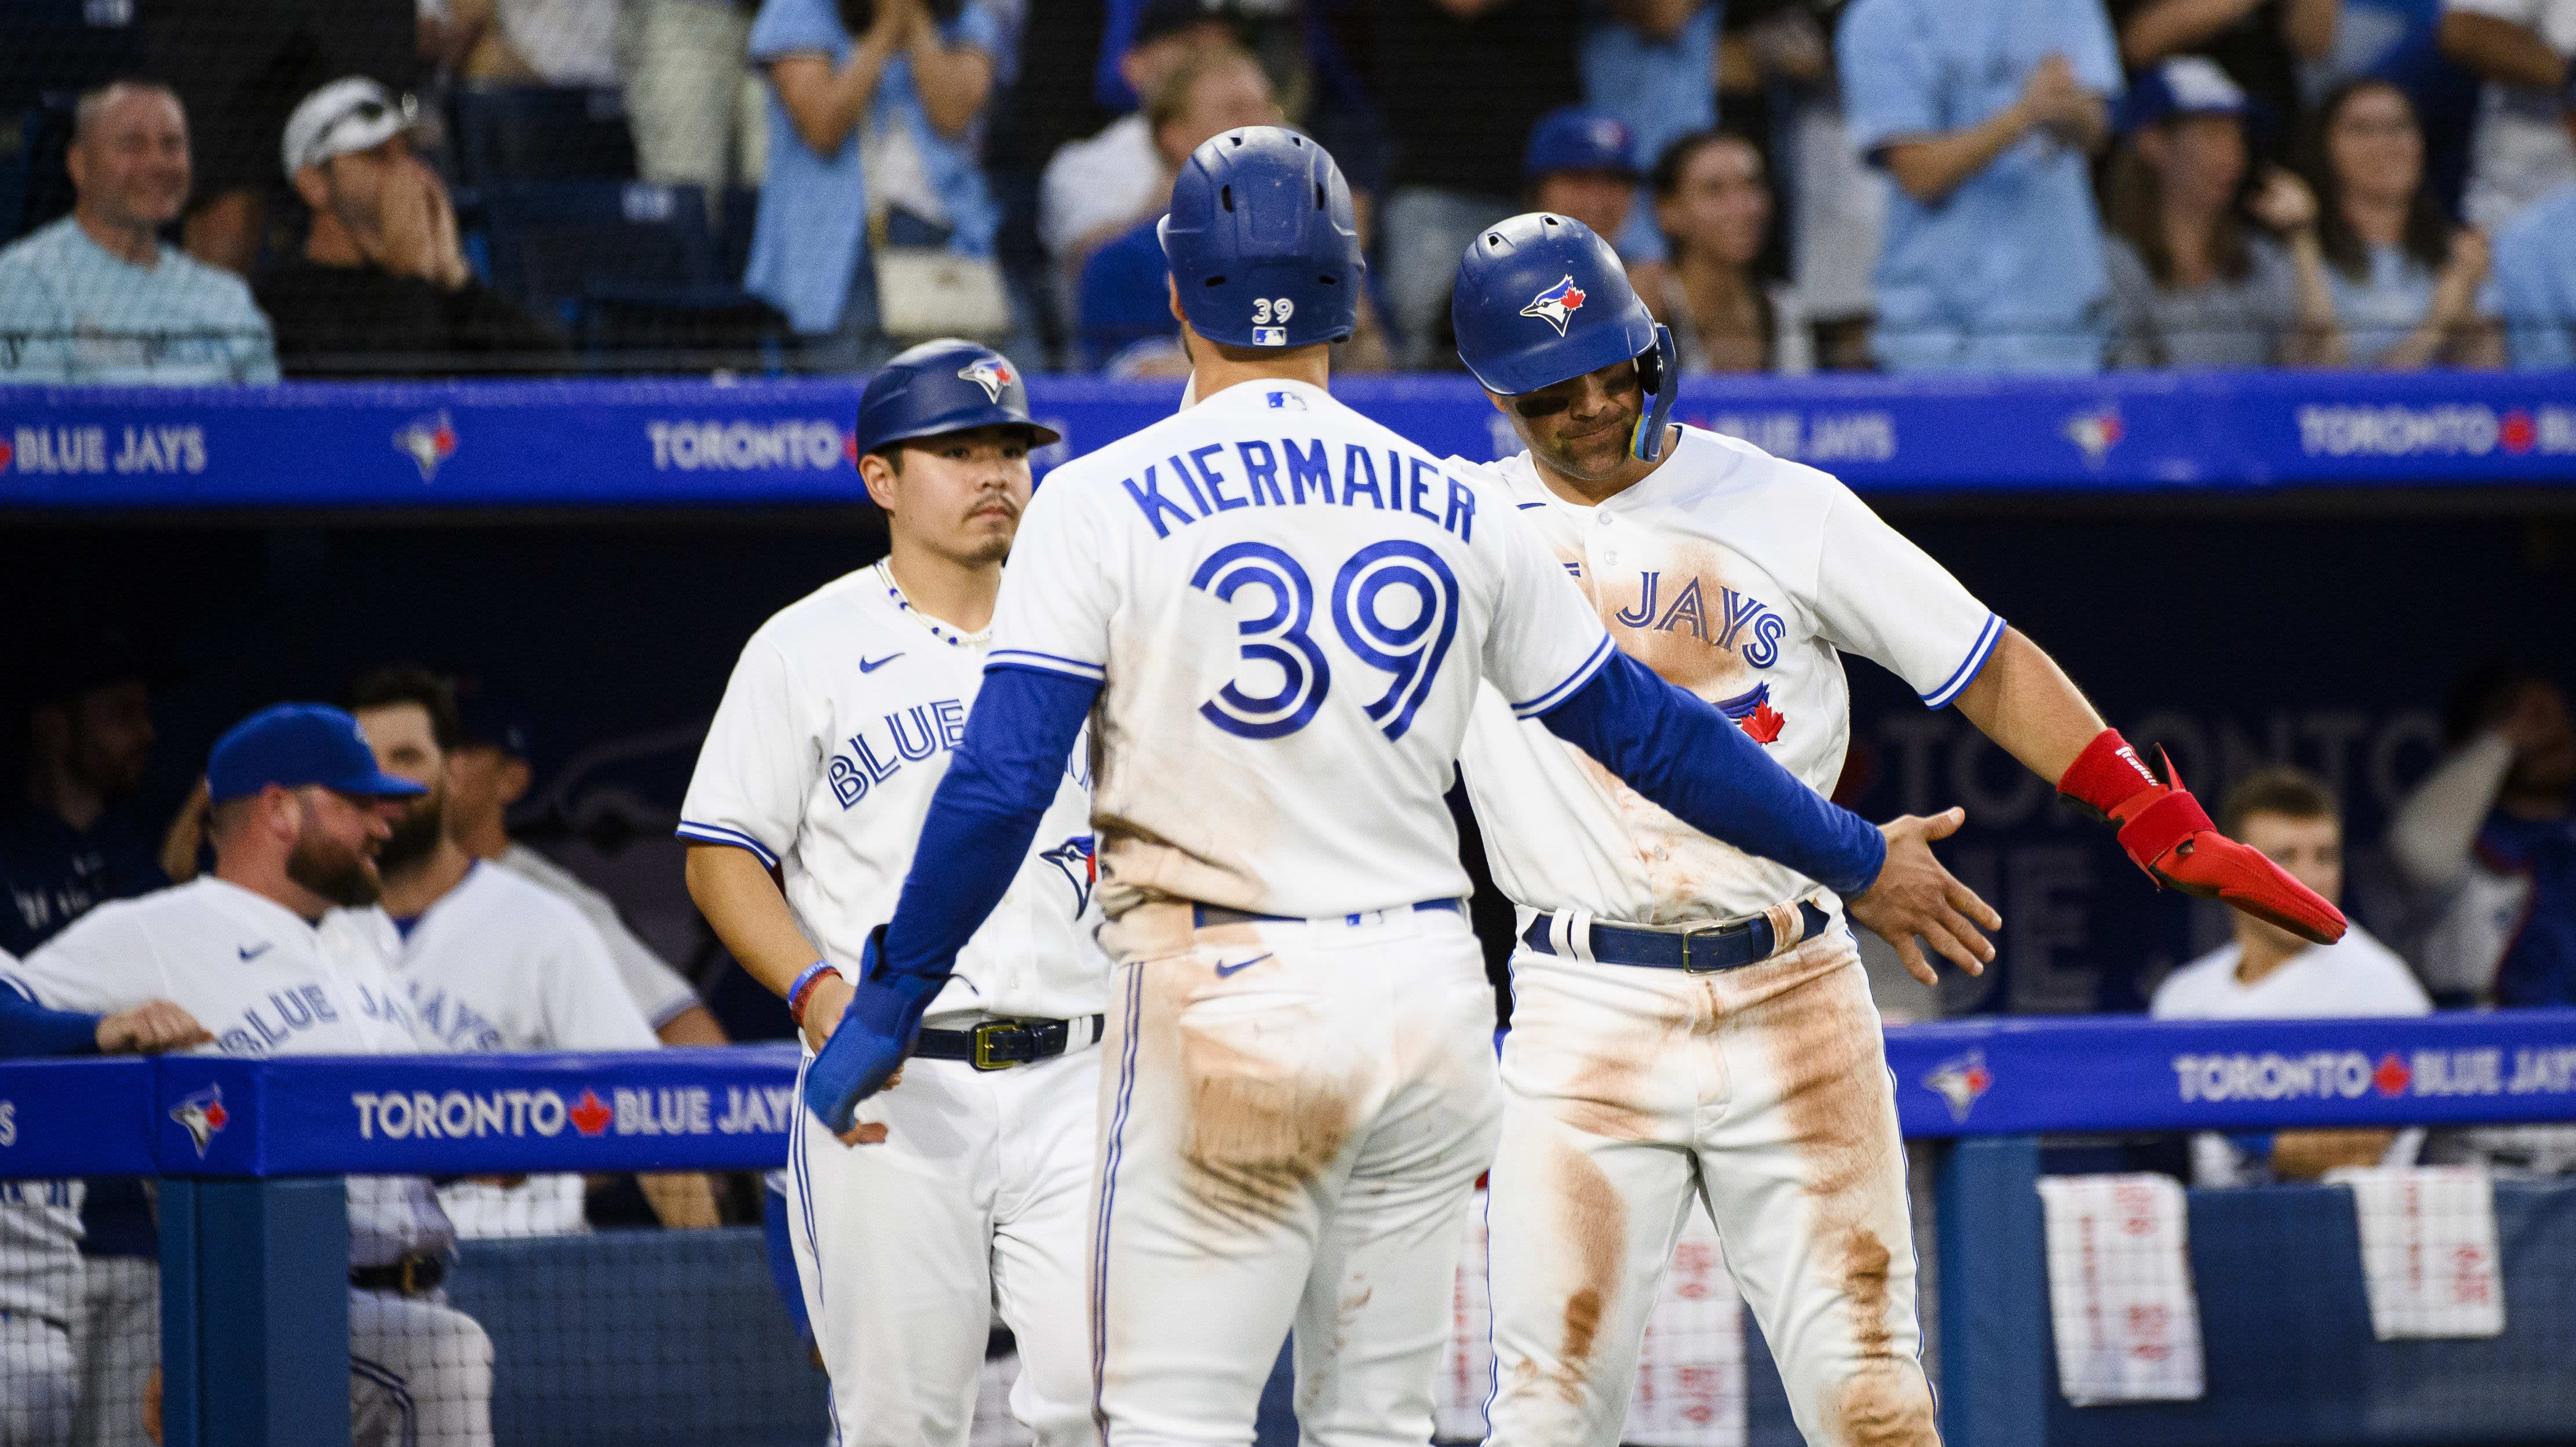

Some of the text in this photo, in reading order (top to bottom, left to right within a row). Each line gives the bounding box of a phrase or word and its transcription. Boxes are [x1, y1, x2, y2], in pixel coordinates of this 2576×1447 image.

[1251, 298, 1294, 324] 39
[15, 423, 207, 473] BLUE JAYS
[648, 420, 842, 472] TORONTO
[1121, 438, 1476, 545] KIERMAIER
[1190, 539, 1459, 743] 39
[1616, 571, 1786, 668] JAYS
[829, 699, 964, 811] BLUE
[1882, 708, 2450, 830] TOONTO
[353, 1086, 793, 1140] TORONTO BLUE JAY
[2174, 1047, 2576, 1103] TORONTO BLUE JAY
